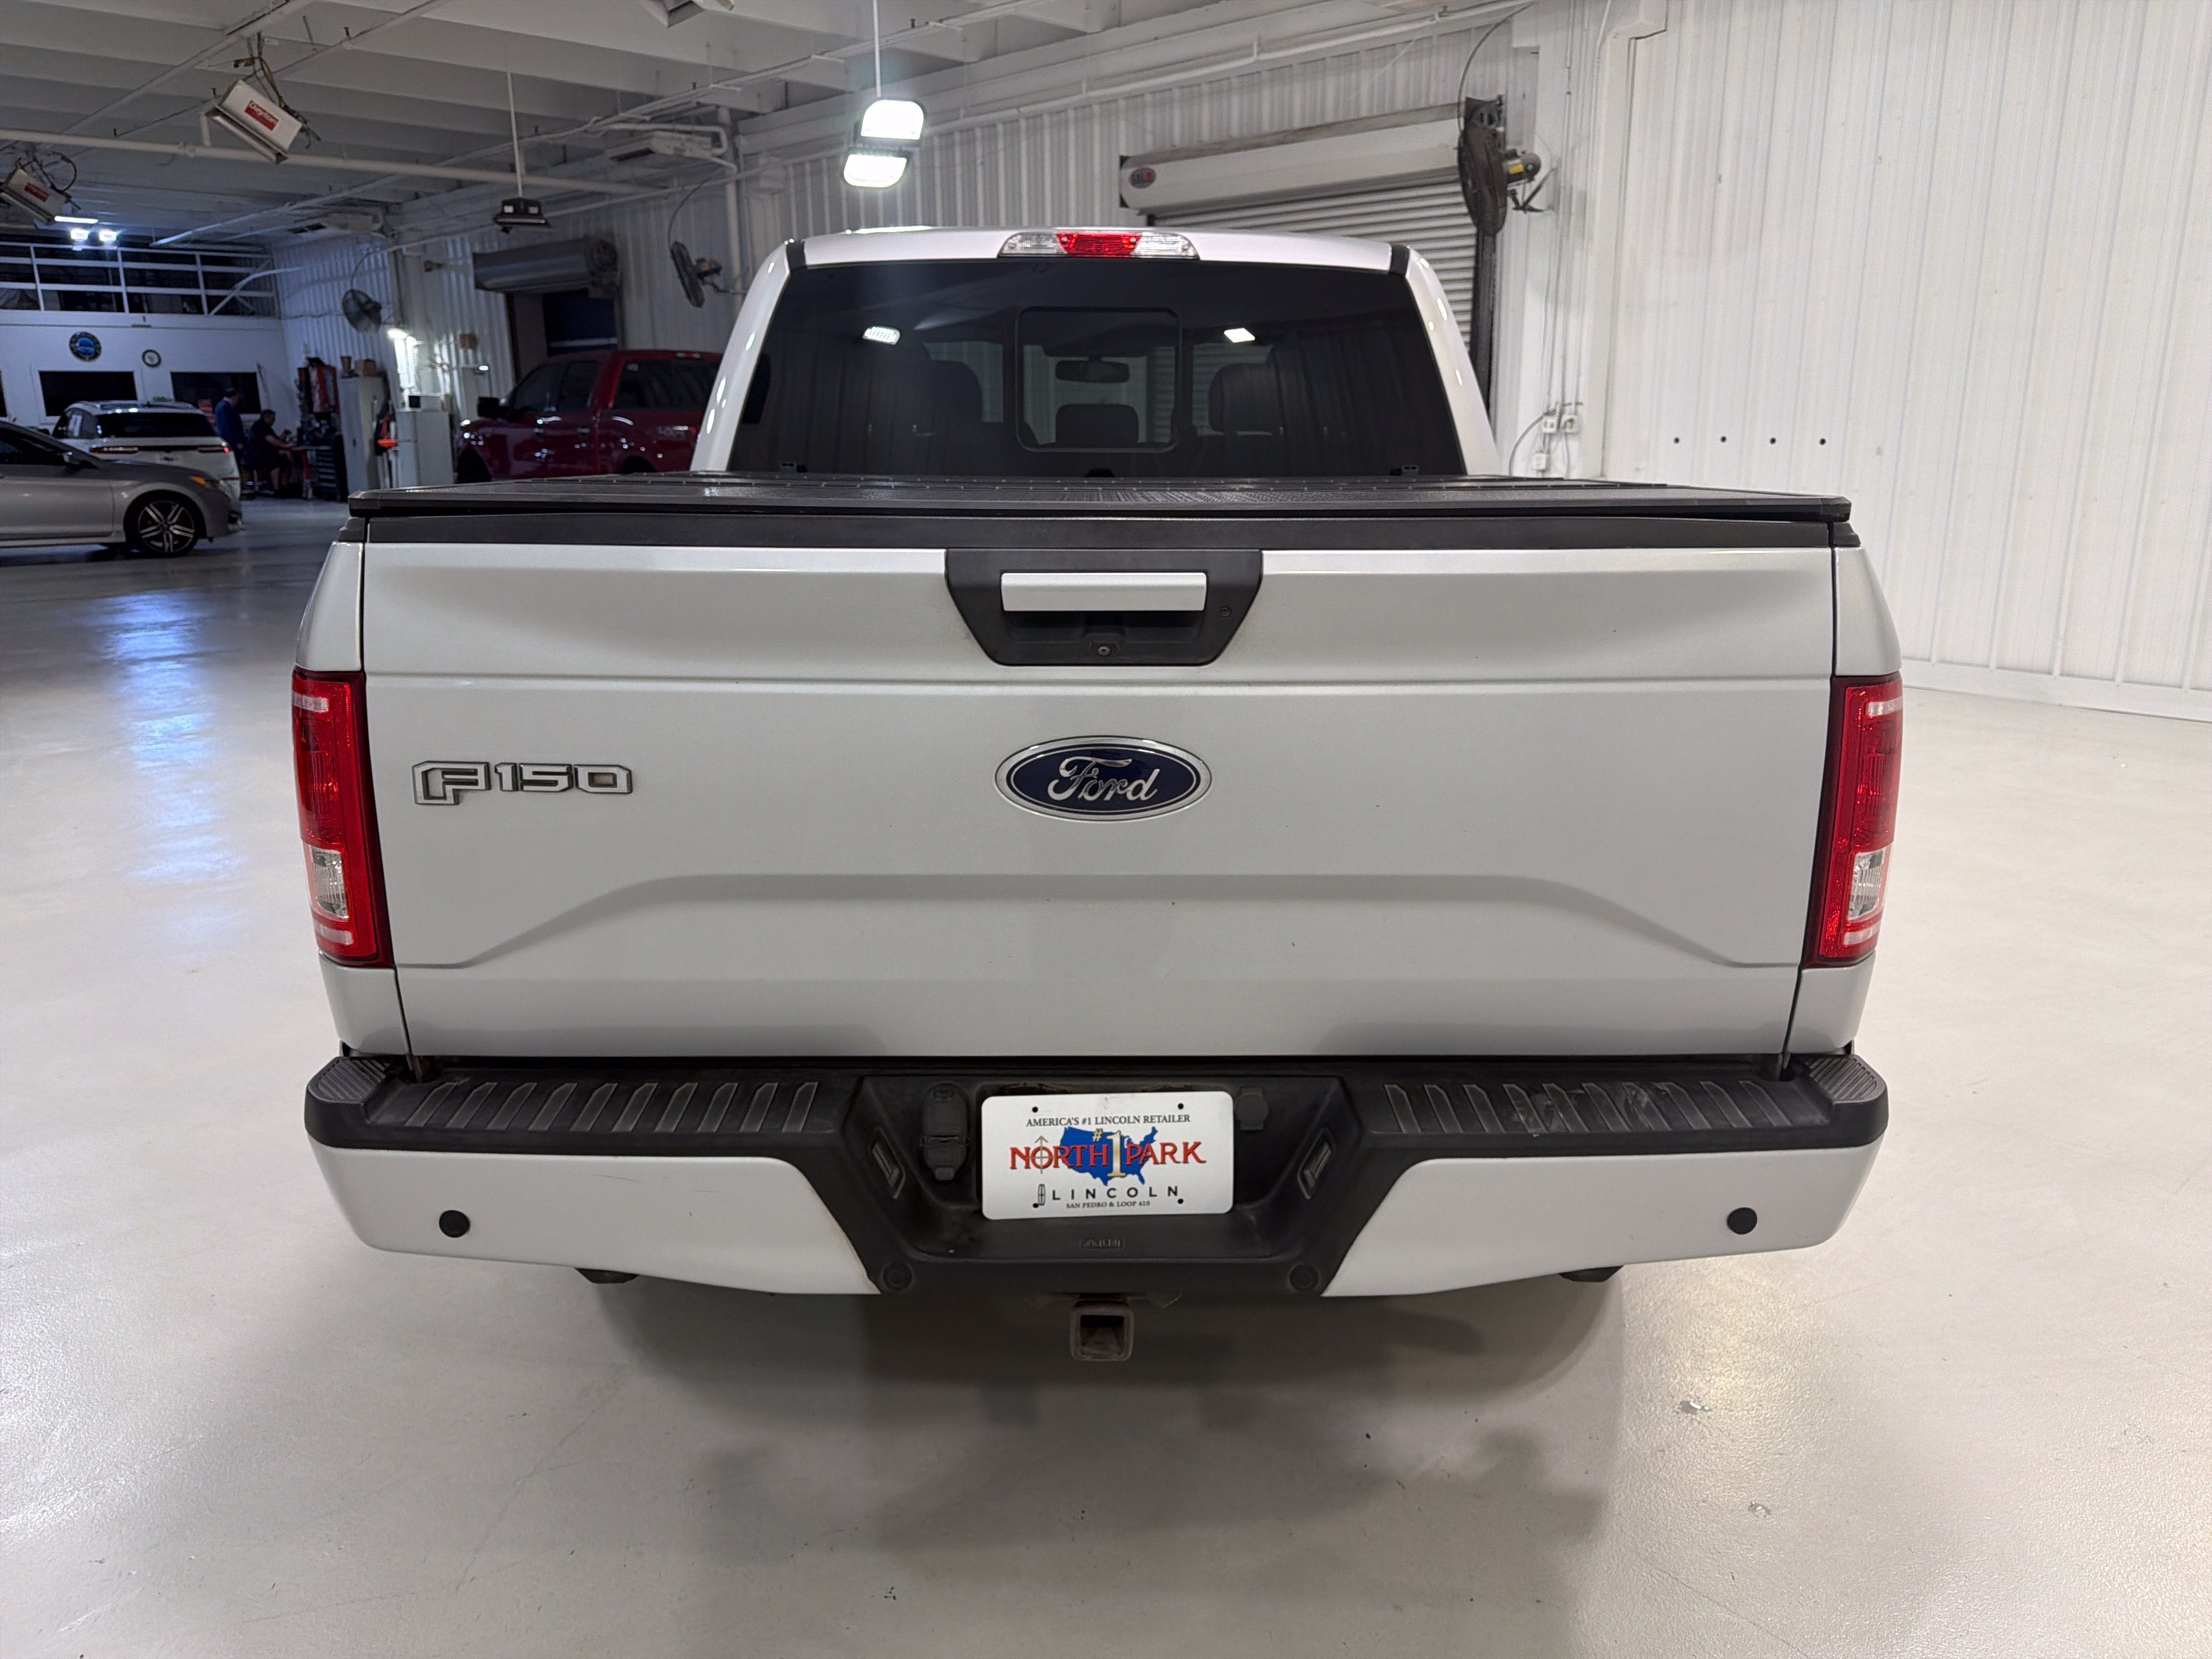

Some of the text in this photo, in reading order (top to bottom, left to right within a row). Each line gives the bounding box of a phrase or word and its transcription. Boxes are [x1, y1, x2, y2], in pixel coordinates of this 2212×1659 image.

[1047, 756, 1160, 801] Ford
[1026, 1114, 1190, 1127] AMERICA'S #1 LINCOLN RETAILER
[1010, 1141, 1207, 1170] NORTH PARK
[1052, 1186, 1178, 1200] LINCOLN
